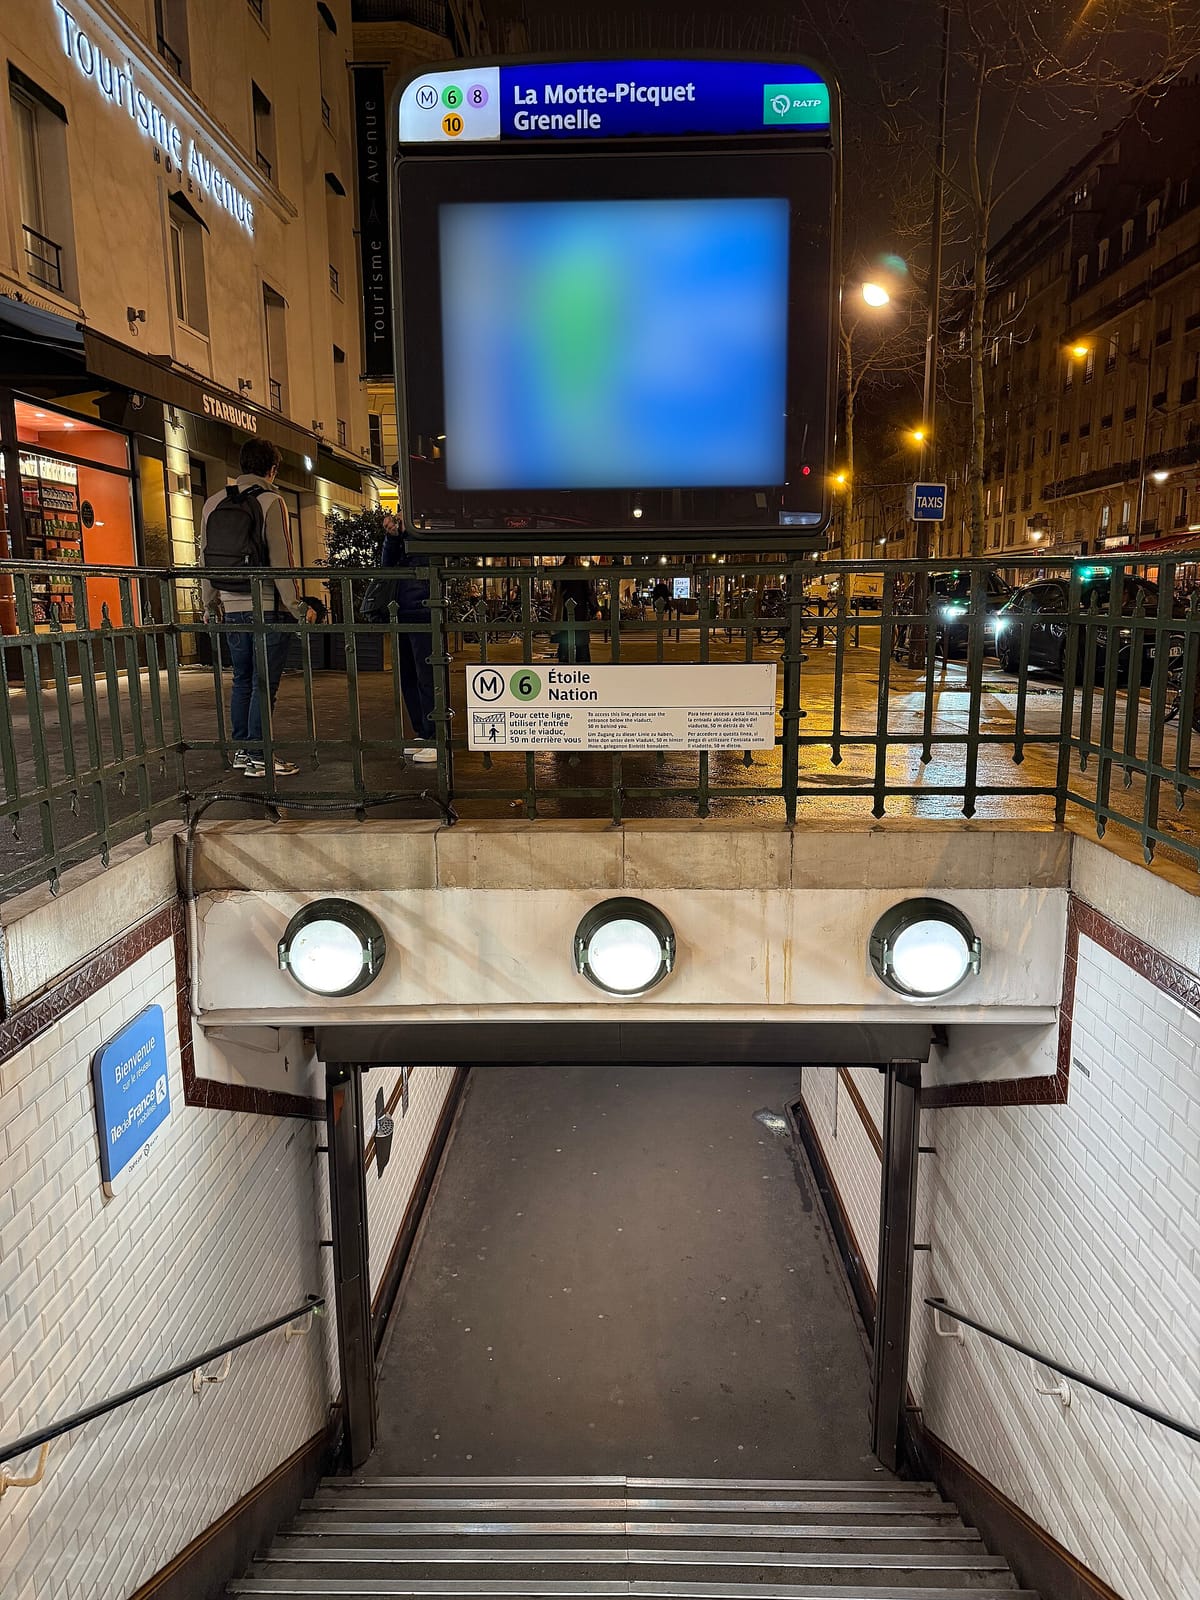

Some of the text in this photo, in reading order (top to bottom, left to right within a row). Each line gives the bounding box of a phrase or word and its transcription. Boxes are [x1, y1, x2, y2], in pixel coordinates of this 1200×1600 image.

[448, 90, 457, 104] 6
[473, 90, 482, 104] 8
[514, 82, 696, 107] La Motte-Picquet
[792, 99, 822, 108] RATP
[54, 0, 255, 234] Tourisme Avenue
[444, 118, 461, 132] 10
[514, 109, 601, 130] Grenelle
[365, 100, 385, 343] Tourisme Avenue
[202, 394, 257, 433] STARBUCKS
[916, 496, 944, 508] TAXIS
[548, 668, 590, 684] Étoile
[520, 676, 532, 695] 6
[548, 688, 598, 701] Nation
[552, 712, 572, 720] ligne,
[538, 728, 566, 736] viaduc,
[115, 1036, 156, 1084] Bienvenue
